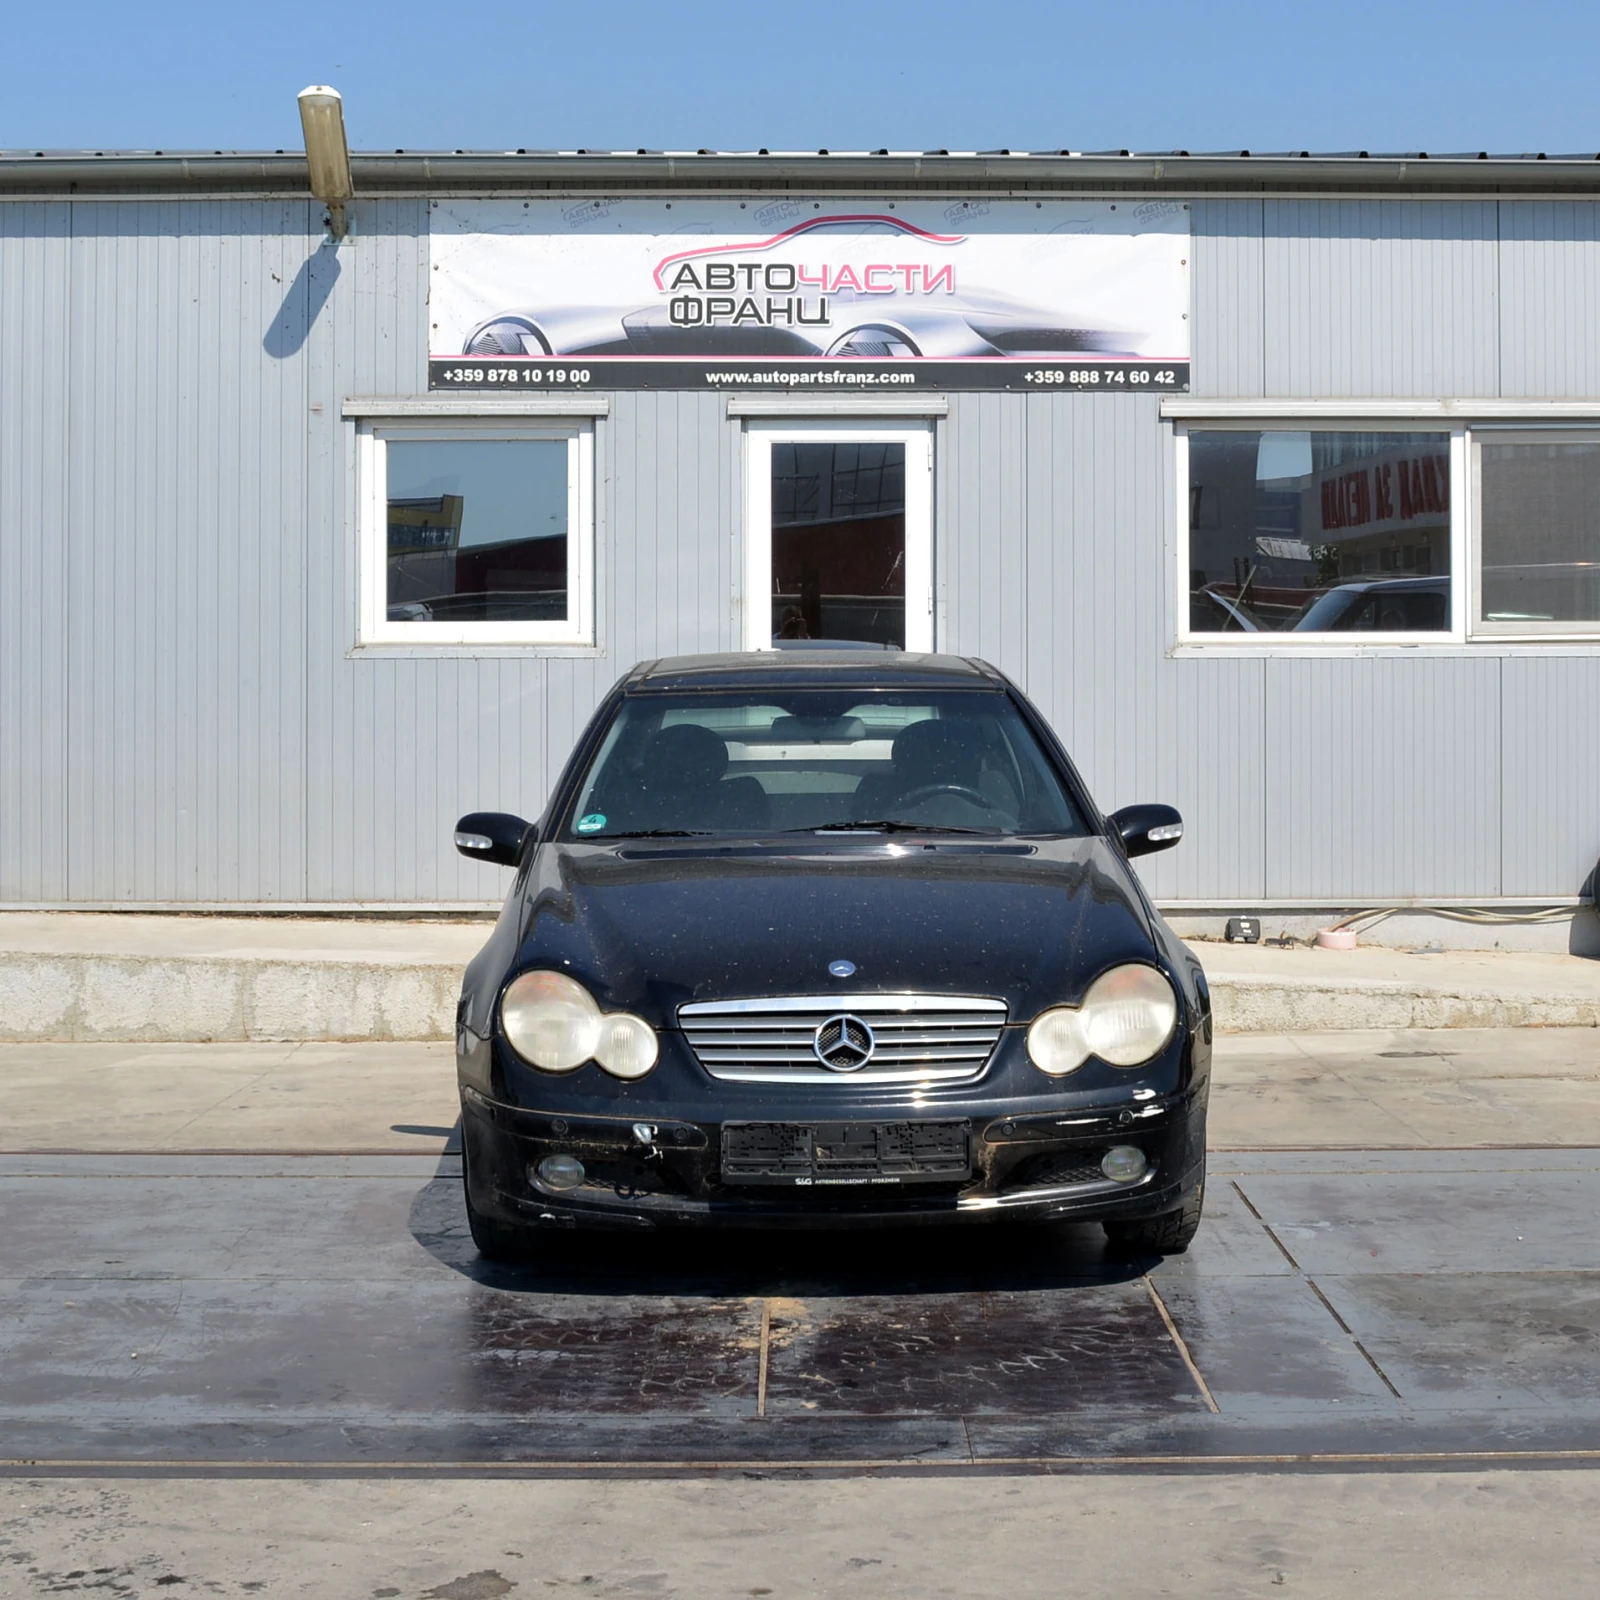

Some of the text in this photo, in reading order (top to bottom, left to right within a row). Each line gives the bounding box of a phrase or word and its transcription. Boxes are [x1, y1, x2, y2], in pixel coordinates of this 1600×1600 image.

[670, 263, 954, 292] АВТОЧАСТИ
[669, 295, 830, 326] ФРАНЦ
[443, 369, 591, 383] +359 878 10 19 00
[705, 370, 915, 386] www.autopartsfranz.com
[1024, 371, 1175, 384] +359 888 74 60 42
[588, 815, 597, 824] 4
